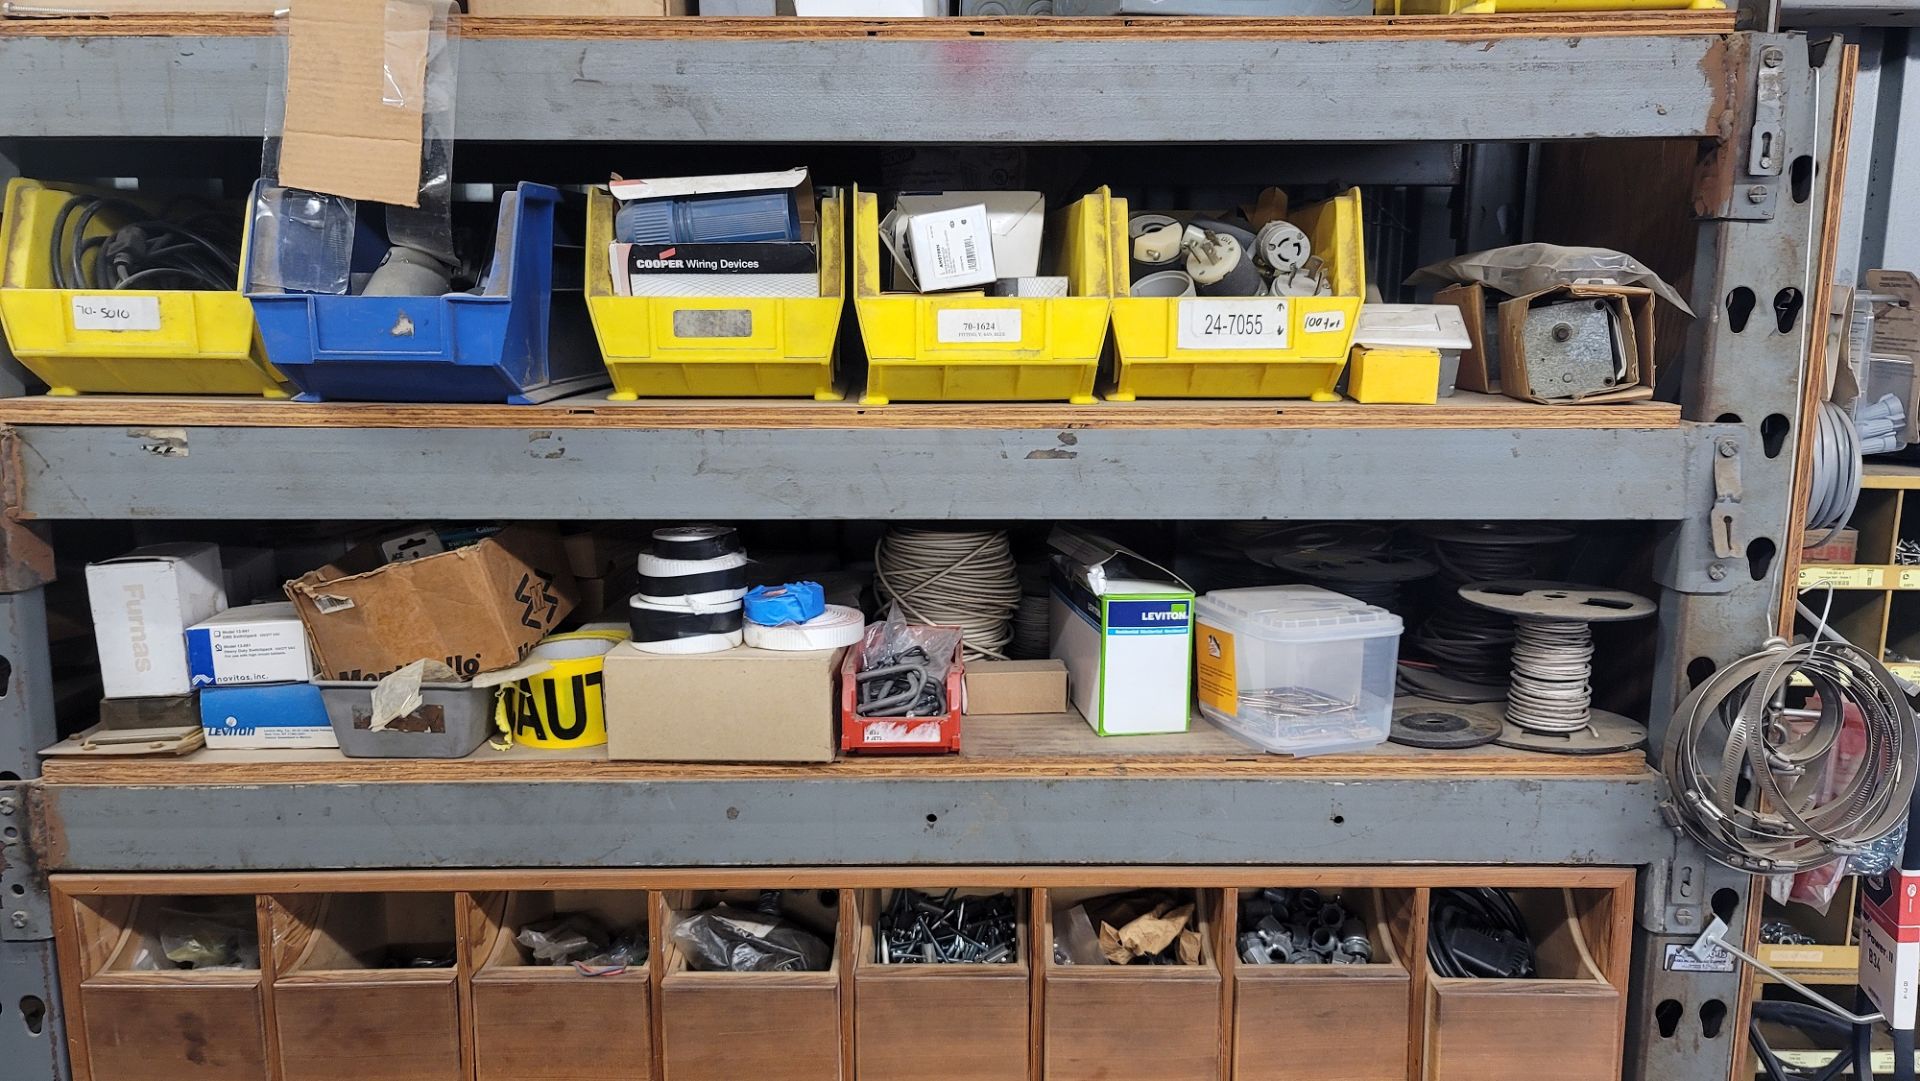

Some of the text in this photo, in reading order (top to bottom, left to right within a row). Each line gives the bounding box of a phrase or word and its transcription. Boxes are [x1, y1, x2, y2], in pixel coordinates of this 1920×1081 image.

[636, 258, 759, 271] COOPER Wiring Devices
[963, 322, 996, 331] 70-1624
[1204, 314, 1263, 335] 24-7055
[1141, 611, 1187, 621] LEVITON
[122, 583, 152, 673] Furnas
[1868, 947, 1881, 972] B34
